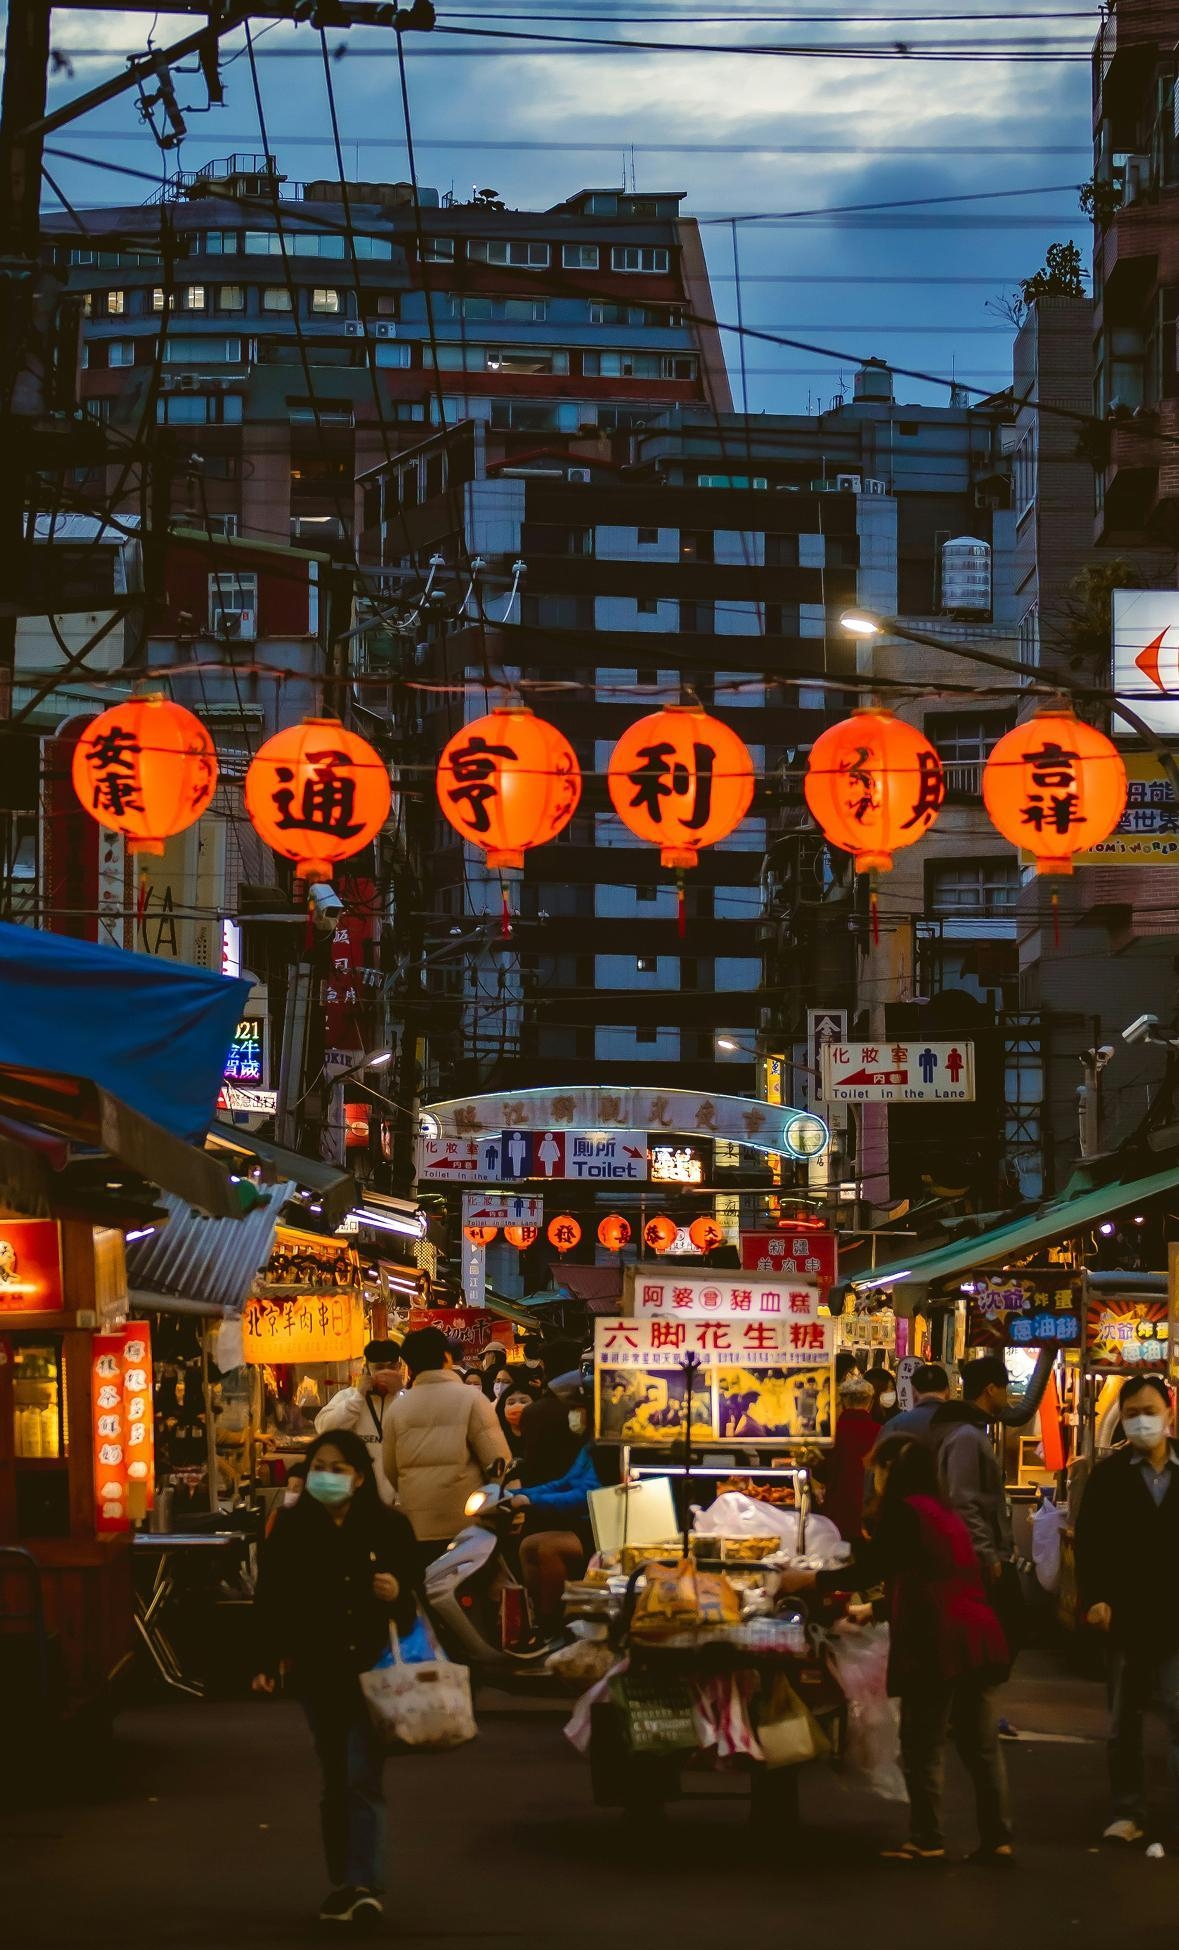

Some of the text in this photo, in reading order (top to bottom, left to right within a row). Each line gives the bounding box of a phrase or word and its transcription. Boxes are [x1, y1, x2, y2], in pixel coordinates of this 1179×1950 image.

[85, 726, 145, 816] 安康
[273, 750, 367, 839] 通
[447, 737, 519, 832] 亨
[628, 742, 716, 830] 利
[1022, 742, 1087, 835] 吉祥
[1129, 841, 1177, 855] WORLD
[832, 1046, 908, 1064] 化妝室
[832, 1088, 965, 1099] Toilet in the Lane
[425, 1141, 479, 1156] 化妝室
[424, 1170, 450, 1178] Toilet
[458, 1170, 467, 1179] in
[572, 1161, 637, 1179] Toilet
[554, 1224, 576, 1243] 發
[615, 1223, 631, 1244] 喜
[646, 1224, 665, 1245] 恭
[768, 1239, 809, 1256] 新疆
[248, 1301, 329, 1337] 北京羊肉串
